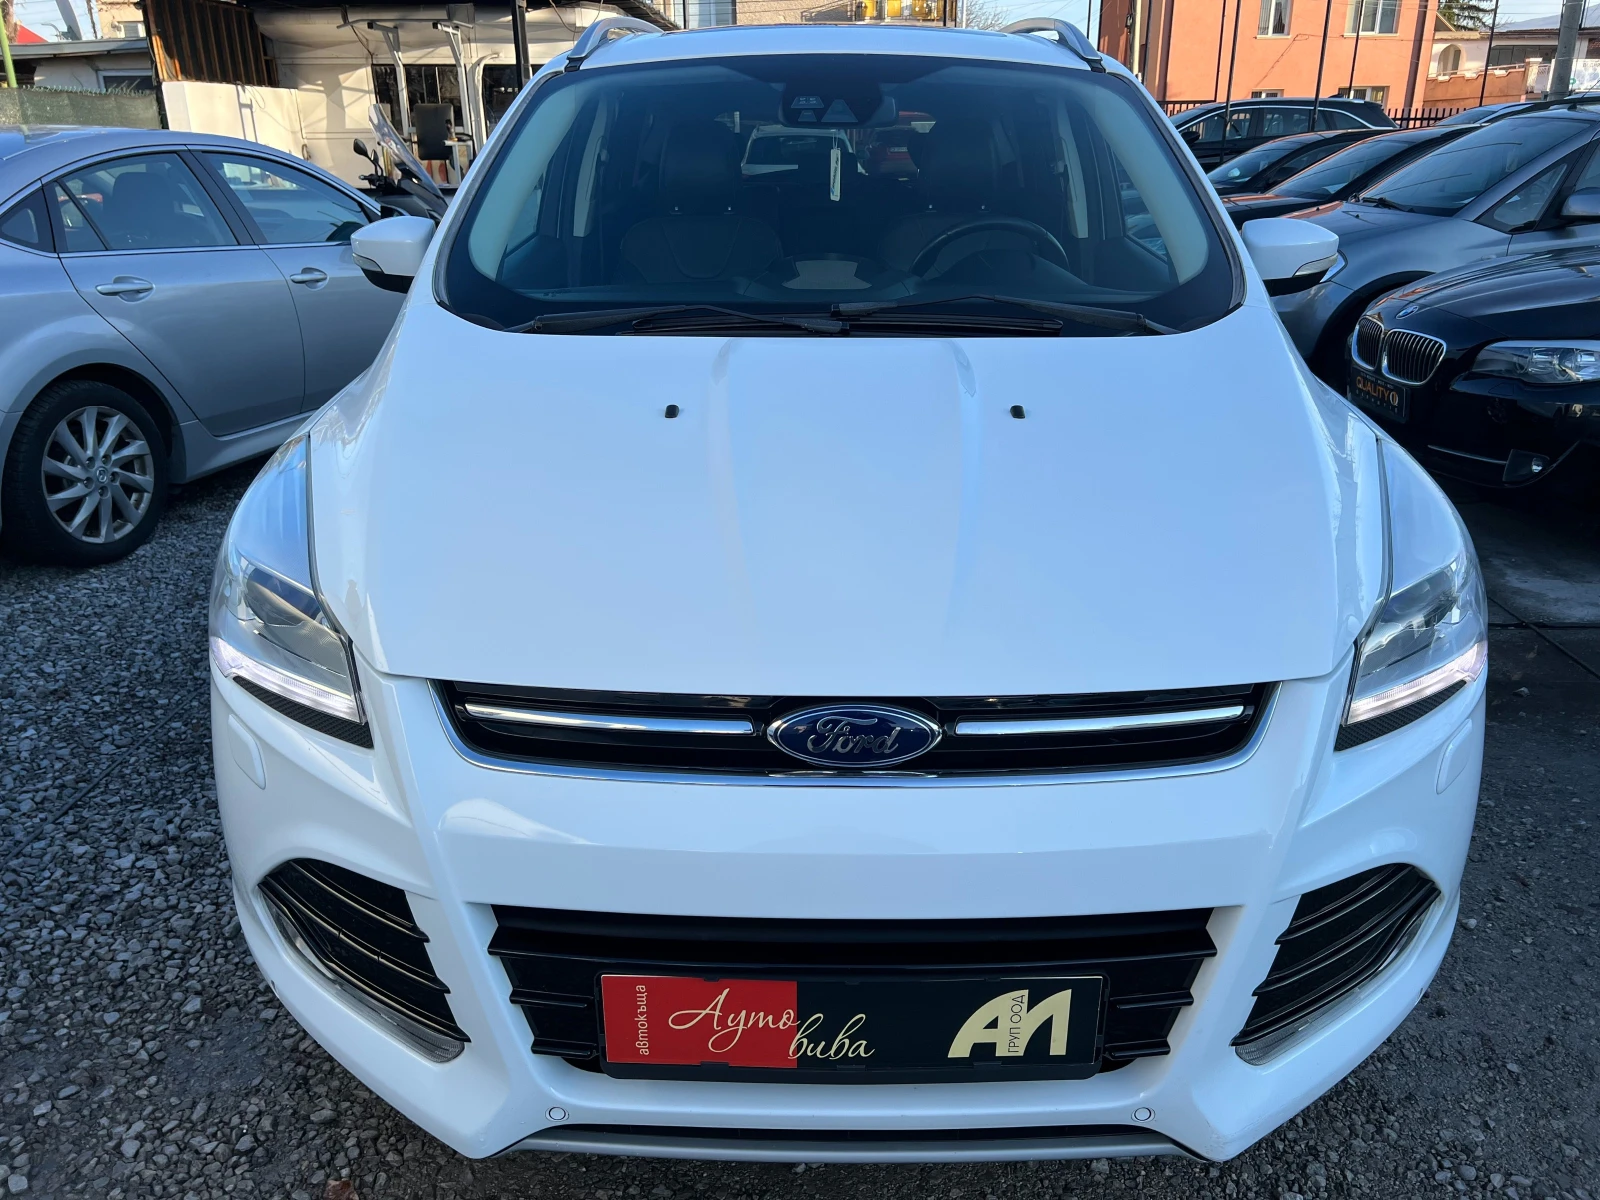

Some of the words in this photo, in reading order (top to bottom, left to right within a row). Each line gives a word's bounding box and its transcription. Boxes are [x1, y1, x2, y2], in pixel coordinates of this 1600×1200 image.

[807, 715, 901, 754] Ford
[634, 984, 650, 1056] автокъща
[668, 987, 801, 1053] Ауто
[1009, 994, 1026, 1024] ООД
[787, 1012, 876, 1060] вива
[1007, 1026, 1021, 1053] ГРУП
